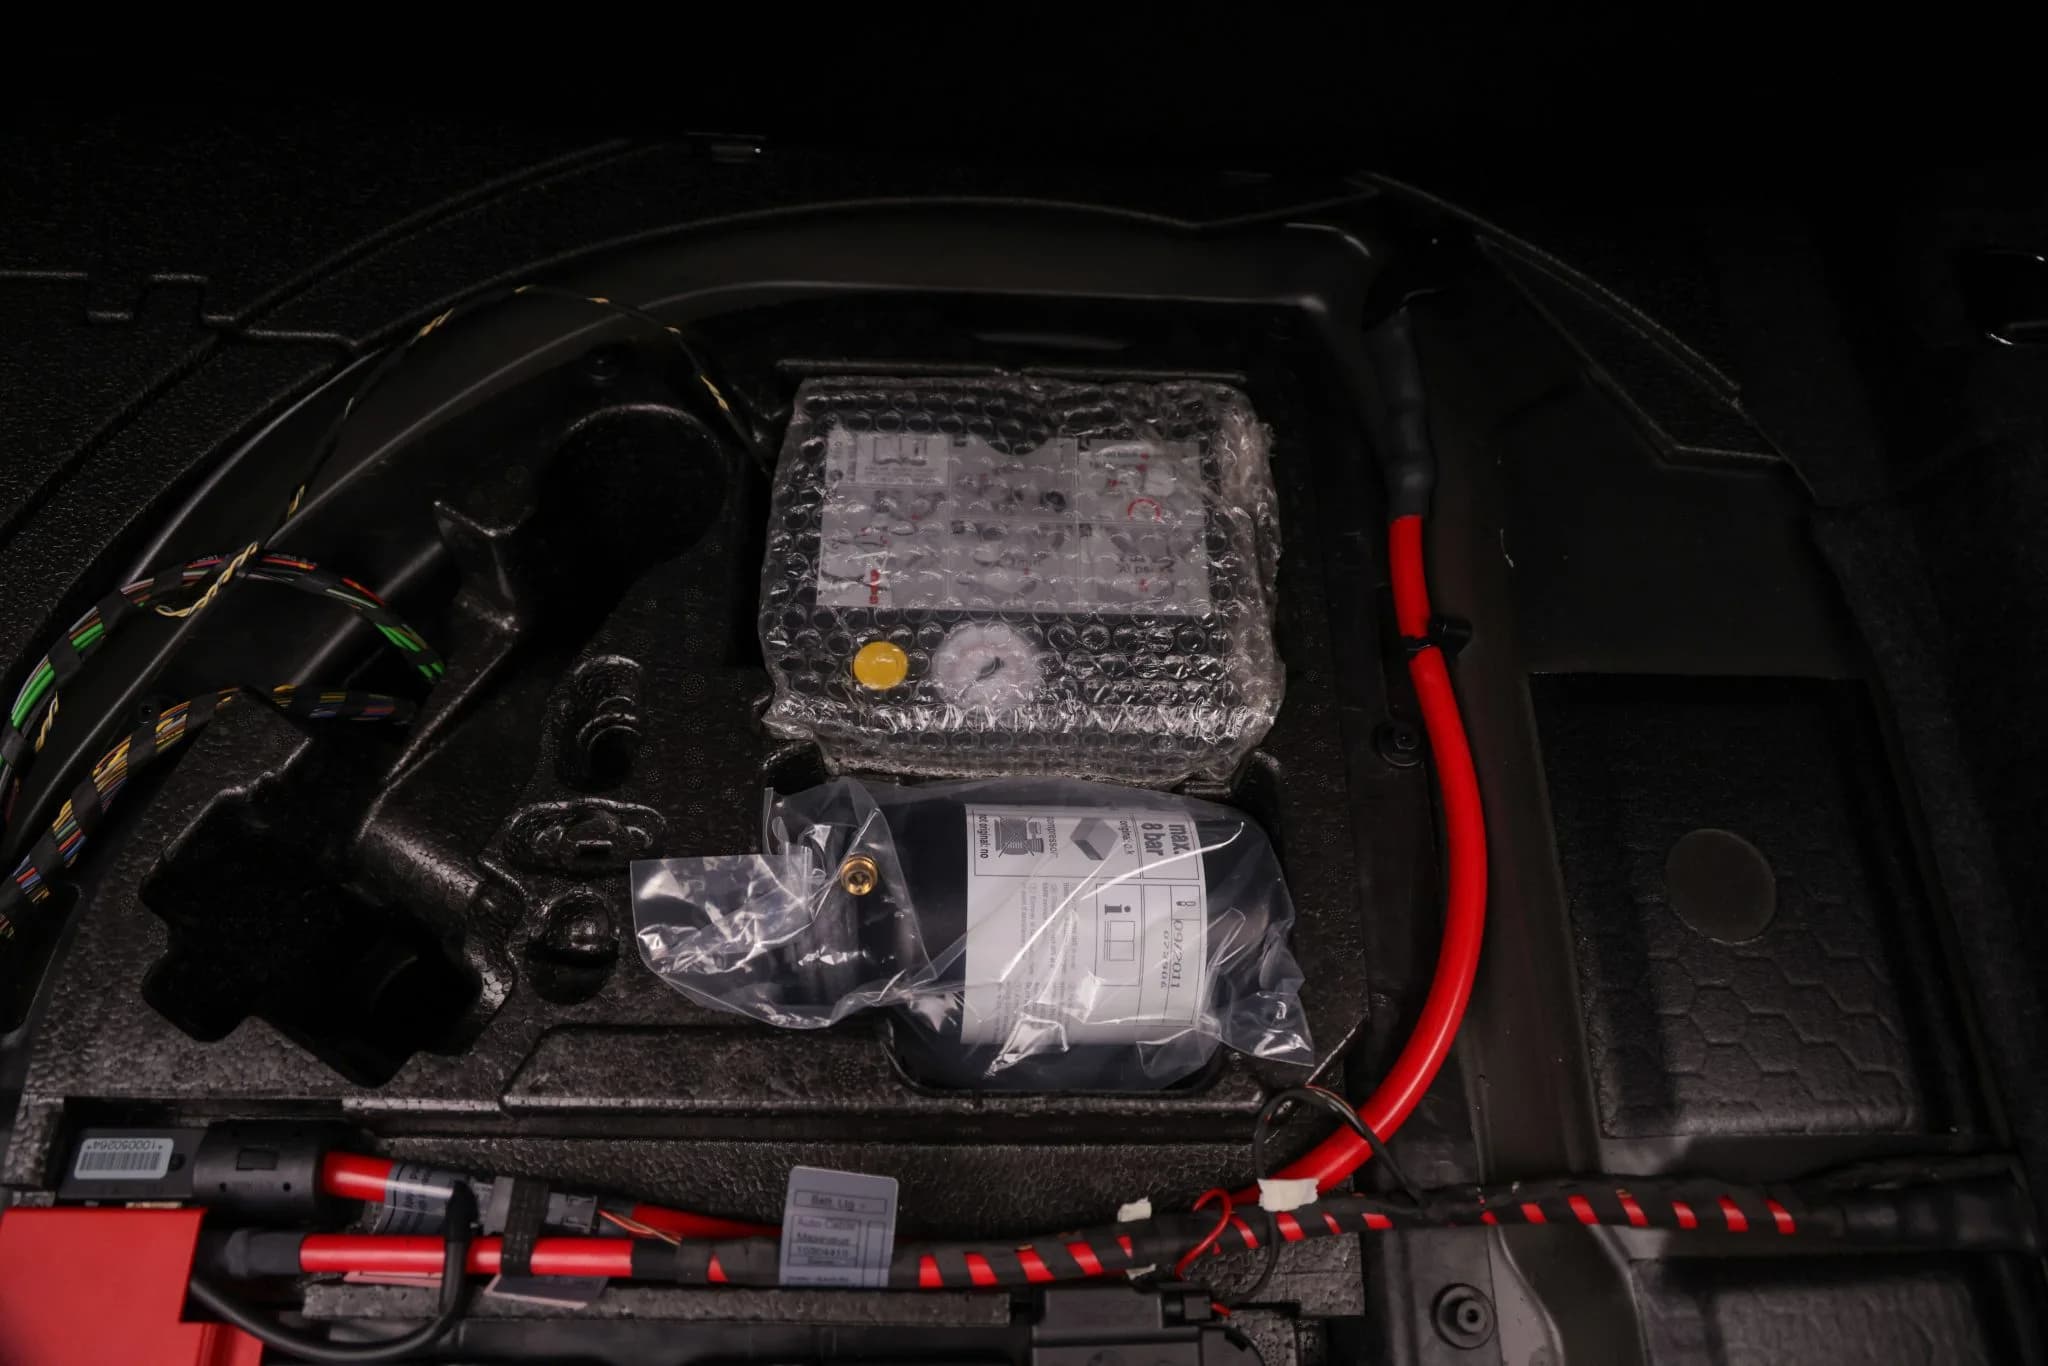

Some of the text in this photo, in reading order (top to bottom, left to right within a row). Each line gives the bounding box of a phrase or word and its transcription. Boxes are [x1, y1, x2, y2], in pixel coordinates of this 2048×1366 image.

[1144, 833, 1166, 856] bar
[1168, 824, 1191, 855] max.
[980, 849, 989, 859] no
[1171, 920, 1184, 988] 09/2011
